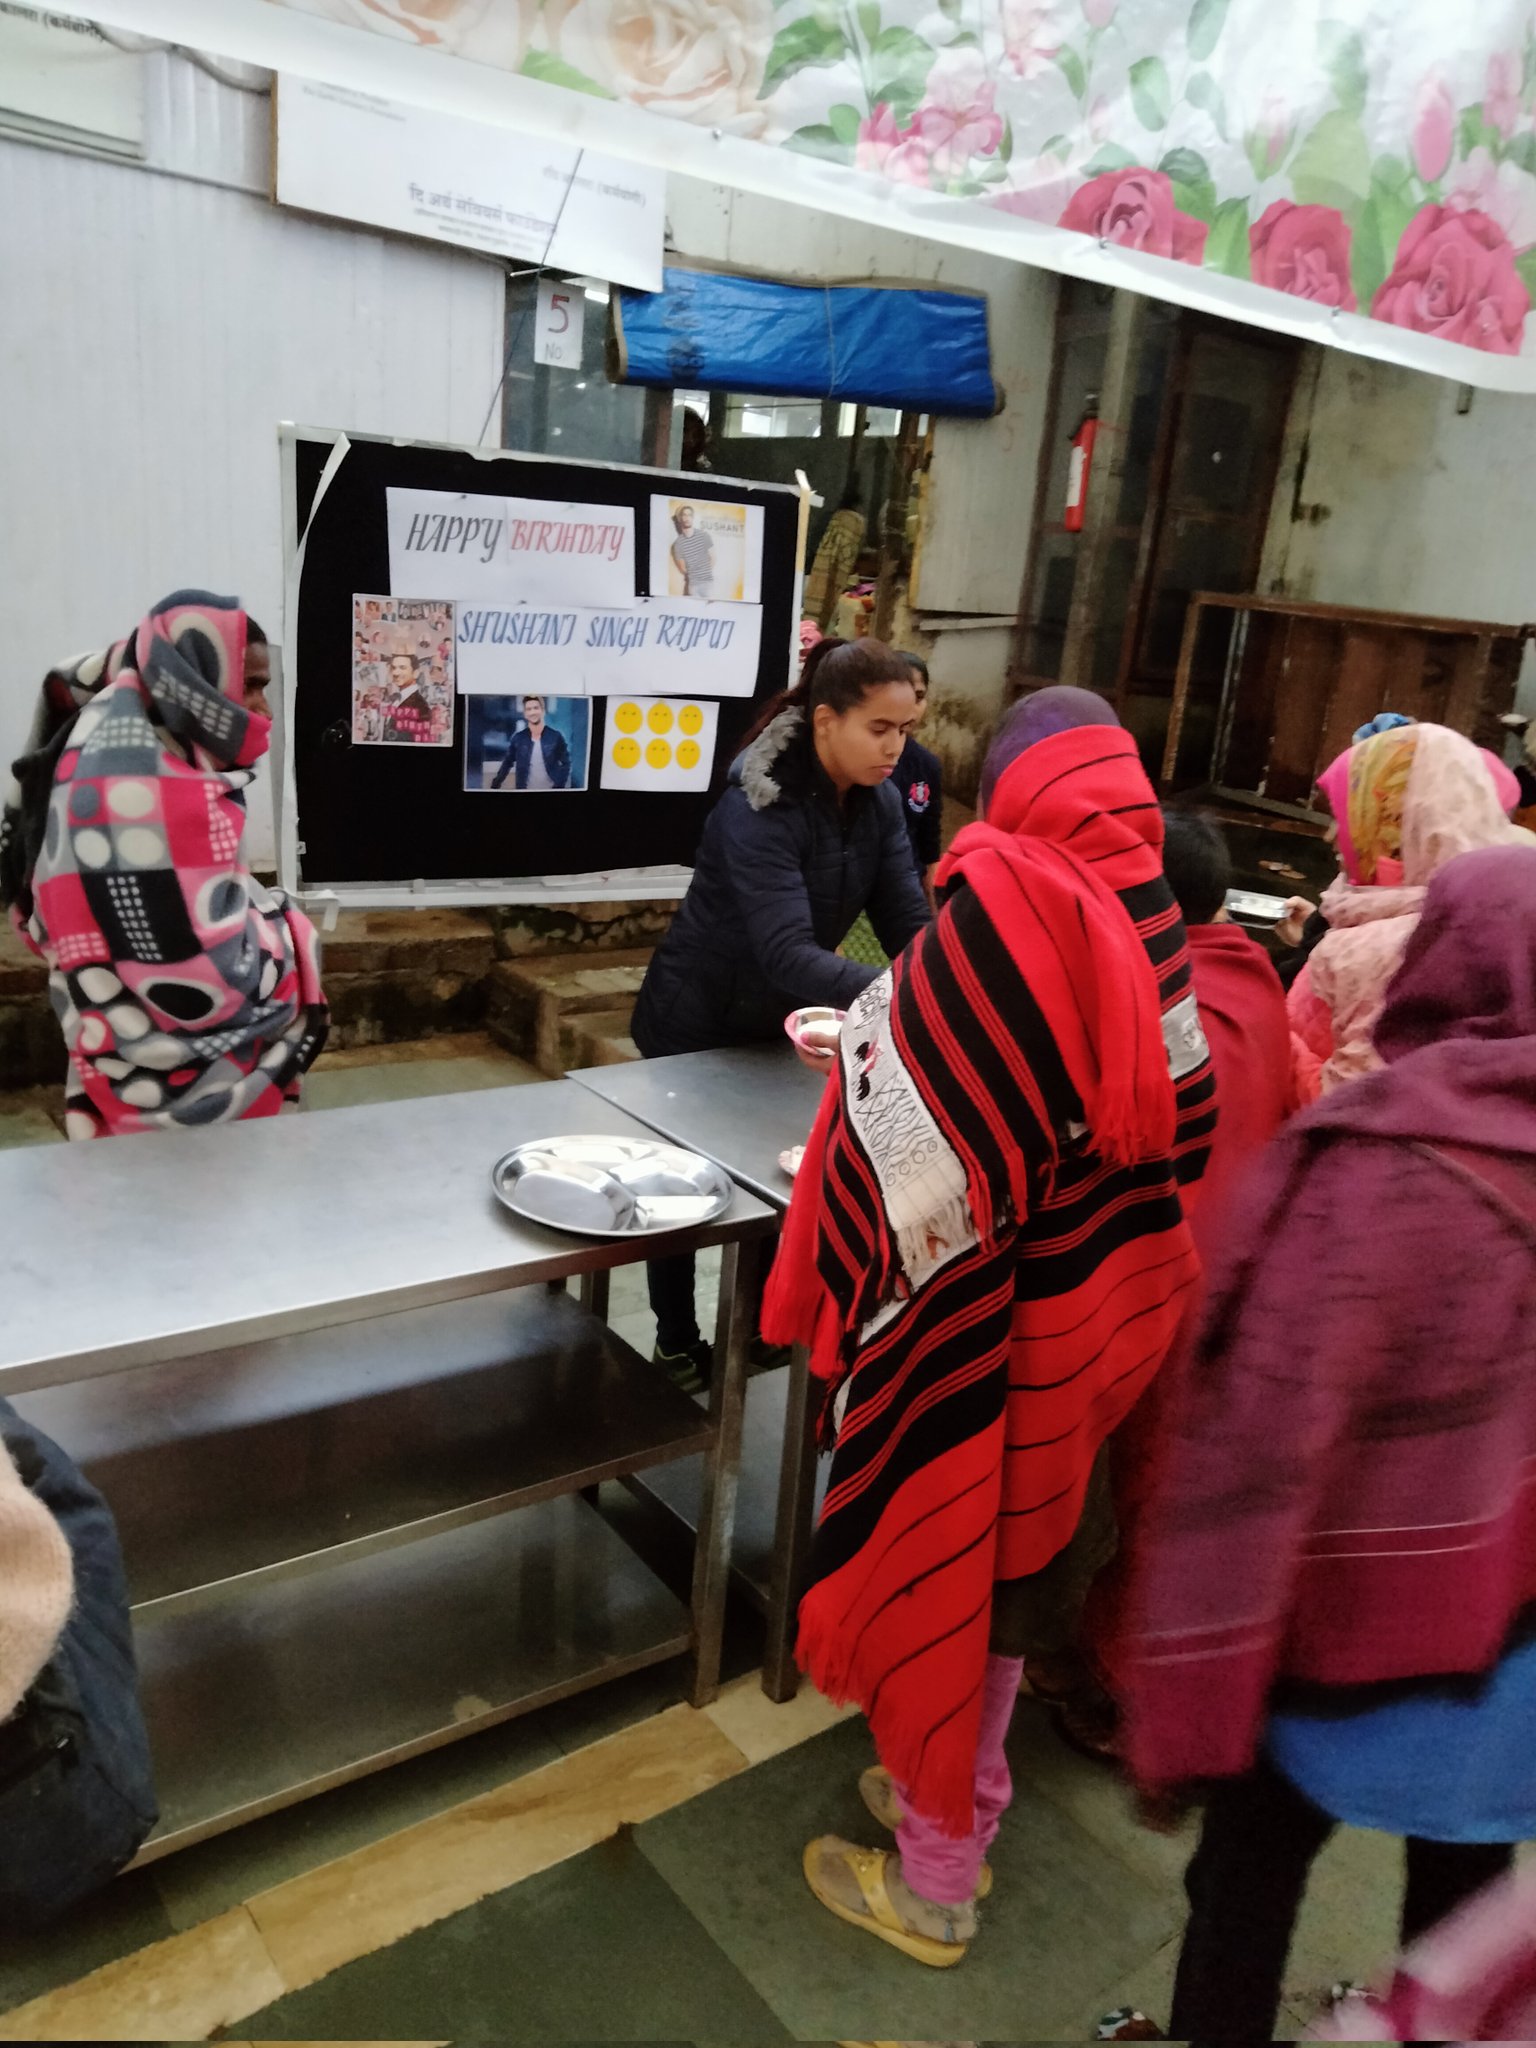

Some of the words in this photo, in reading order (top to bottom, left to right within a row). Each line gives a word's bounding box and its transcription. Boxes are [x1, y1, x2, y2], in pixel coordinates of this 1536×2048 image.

[547, 293, 570, 334] 5
[405, 513, 504, 564] HAPPY
[510, 518, 626, 563] BIRTHDAY
[700, 520, 745, 534] SUSHANT
[585, 616, 650, 657] SINGH
[656, 614, 736, 652] RAJPUT
